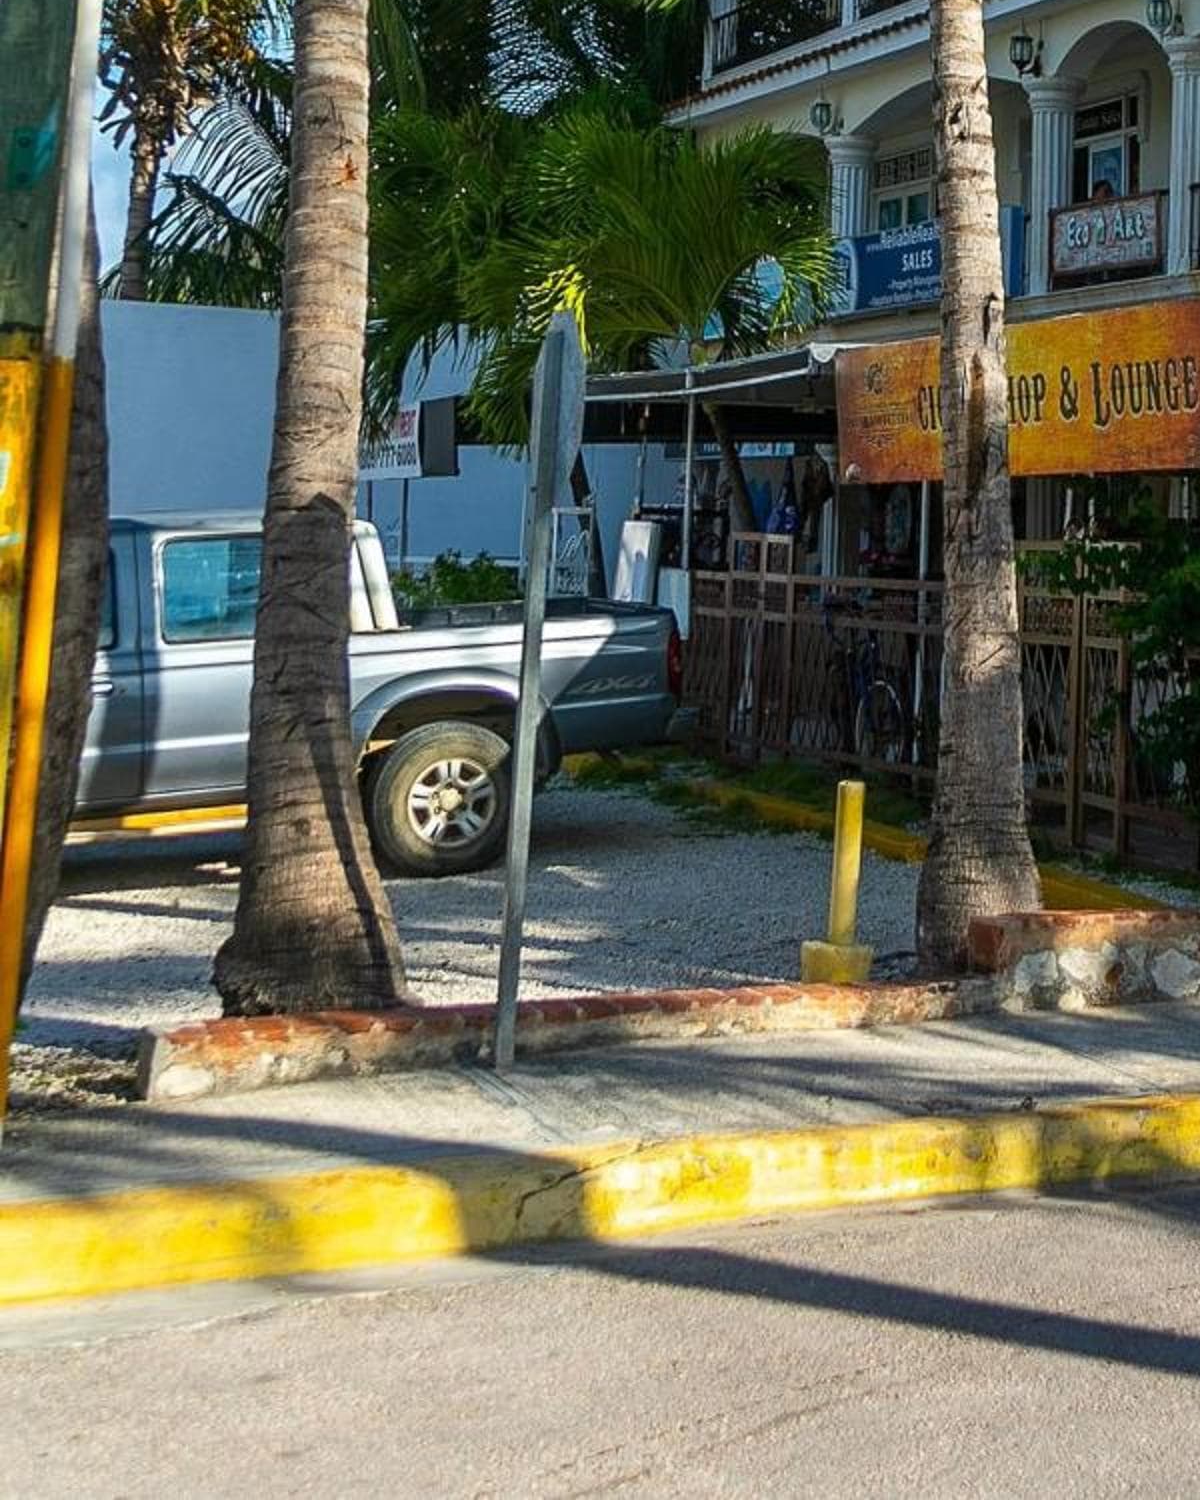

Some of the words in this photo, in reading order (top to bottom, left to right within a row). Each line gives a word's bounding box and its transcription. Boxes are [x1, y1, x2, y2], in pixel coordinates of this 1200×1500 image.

[902, 249, 933, 272] SALES
[1059, 365, 1079, 421] &
[1091, 355, 1199, 428] LOUNGE
